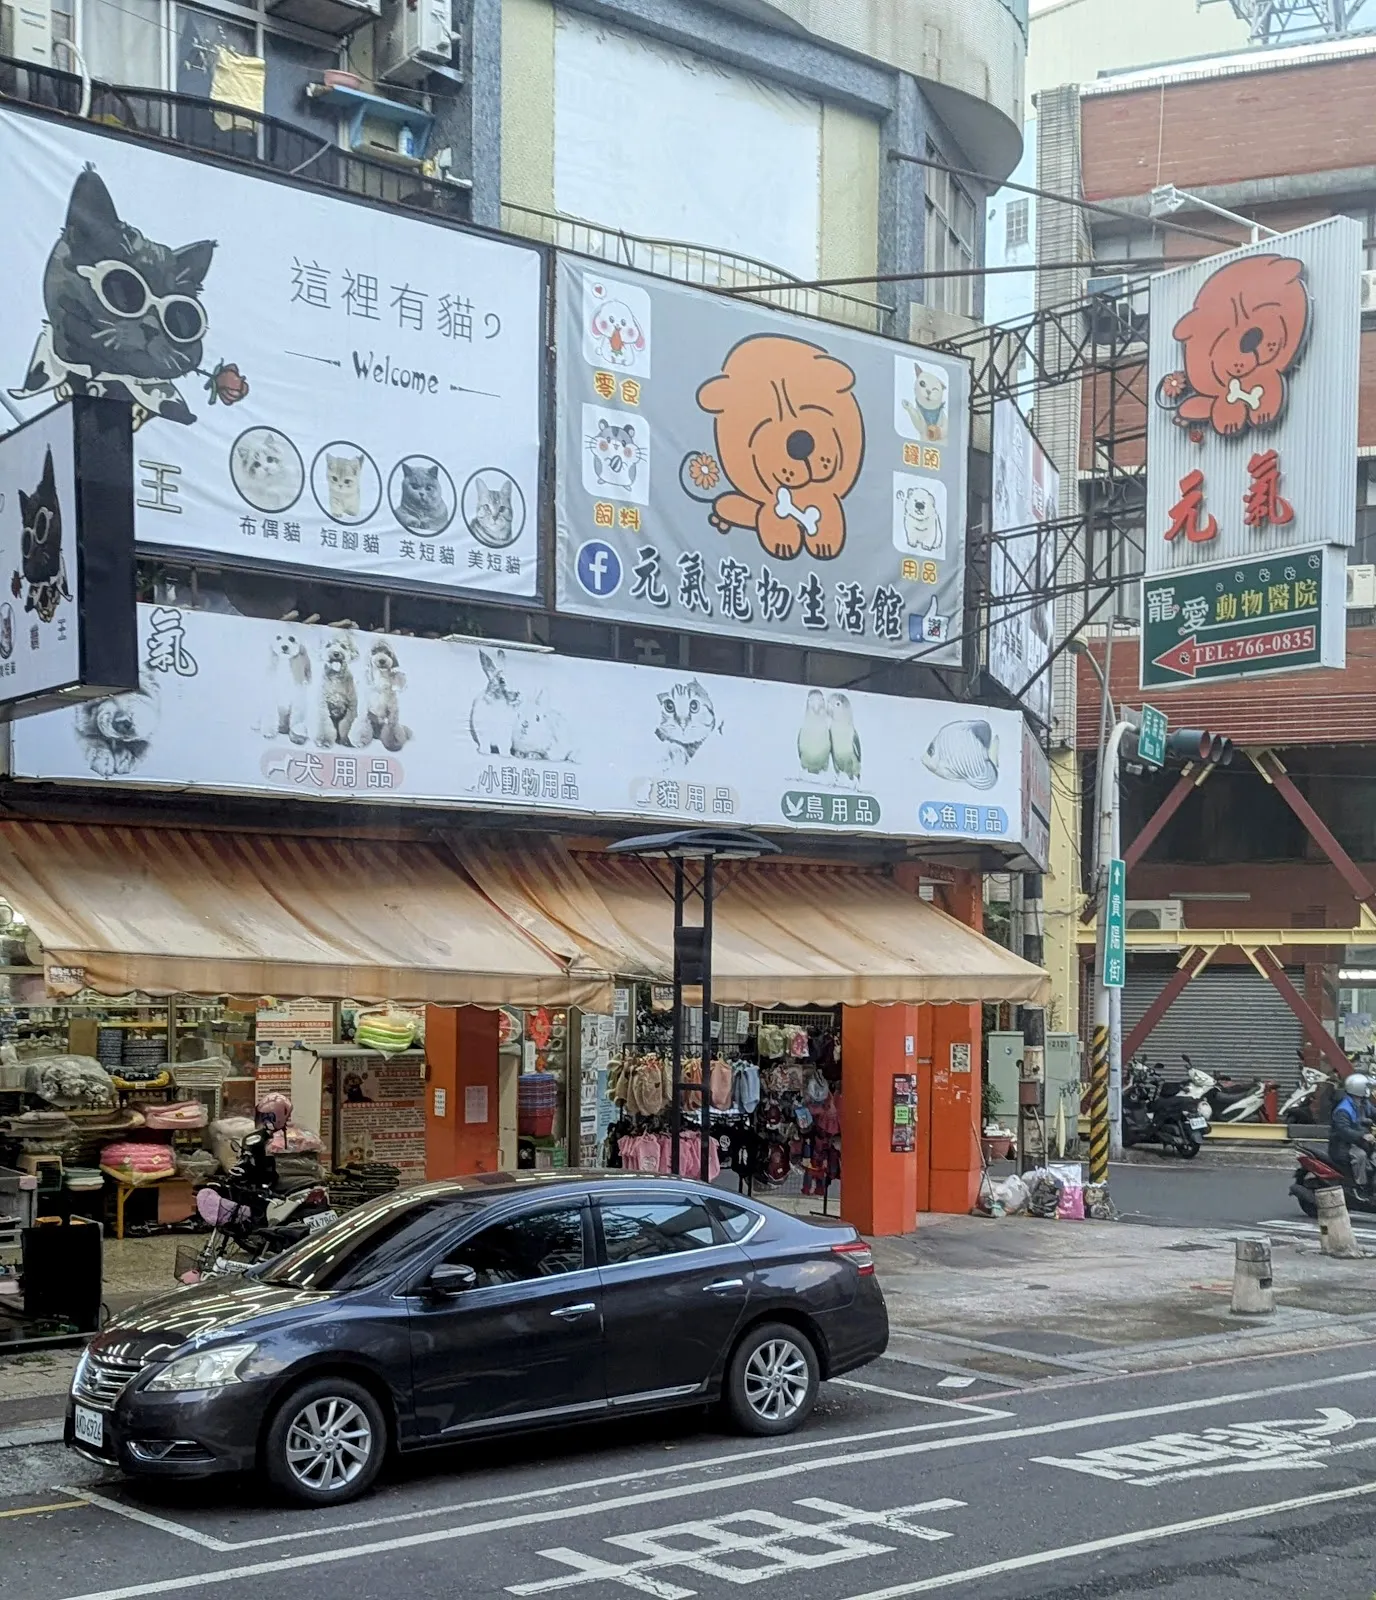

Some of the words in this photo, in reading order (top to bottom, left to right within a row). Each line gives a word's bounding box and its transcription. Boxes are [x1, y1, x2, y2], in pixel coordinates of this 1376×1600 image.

[352, 350, 439, 395] Welcome
[594, 371, 641, 406] 零食
[903, 443, 940, 471] 罐頭
[1163, 448, 1294, 543] 元氣
[239, 515, 301, 543] 布偶貓
[594, 502, 641, 532] 飼料
[320, 527, 380, 555] 短腳貓
[399, 540, 455, 566] 英短貓
[467, 549, 521, 576] 美短貓
[902, 559, 937, 584] 用品
[629, 545, 905, 639] 元氣寵物生活館
[1192, 630, 1313, 664] TEL:766-0835
[294, 754, 394, 789] 犬用品
[479, 764, 580, 801] 小動物用品
[657, 780, 735, 814] 貓用品
[806, 796, 874, 823] 鳥用品
[939, 804, 1004, 833] 魚用品
